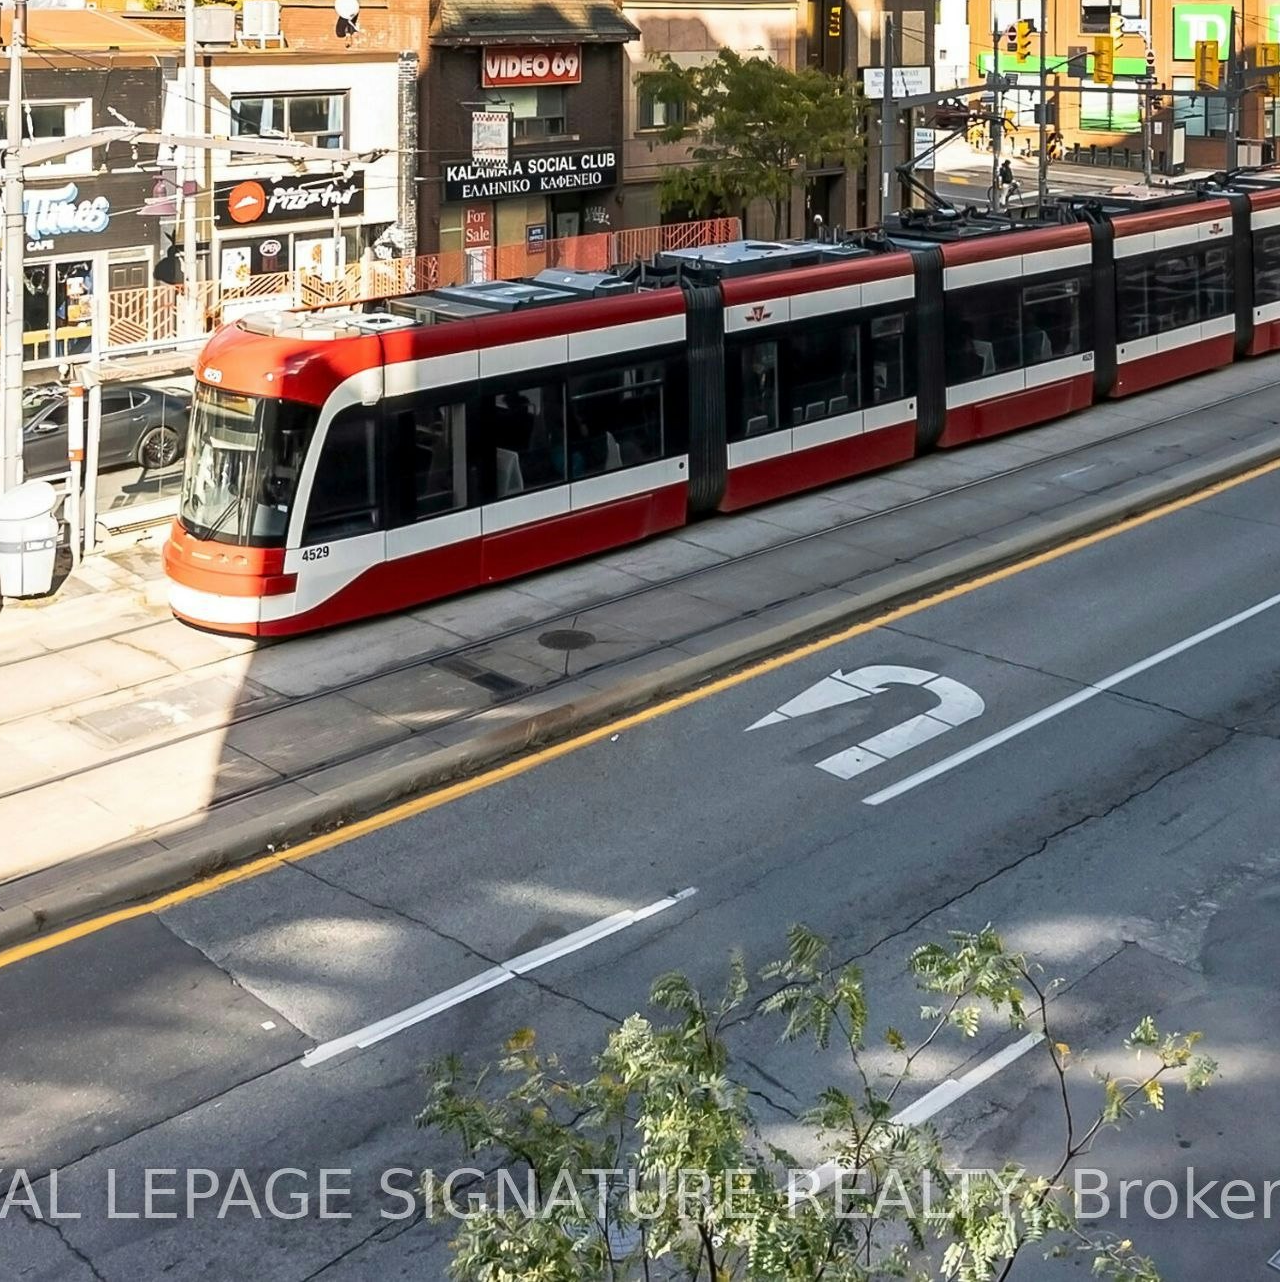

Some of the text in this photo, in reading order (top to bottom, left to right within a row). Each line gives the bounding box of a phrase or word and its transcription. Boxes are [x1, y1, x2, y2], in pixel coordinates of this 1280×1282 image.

[486, 52, 579, 79] VIDEO 69
[528, 155, 577, 174] SOCIAL
[581, 152, 616, 169] CLUB
[22, 182, 110, 240] Times
[466, 209, 486, 224] For
[466, 228, 490, 243] Sale
[26, 239, 54, 251] CAFE
[301, 546, 330, 562] 4529
